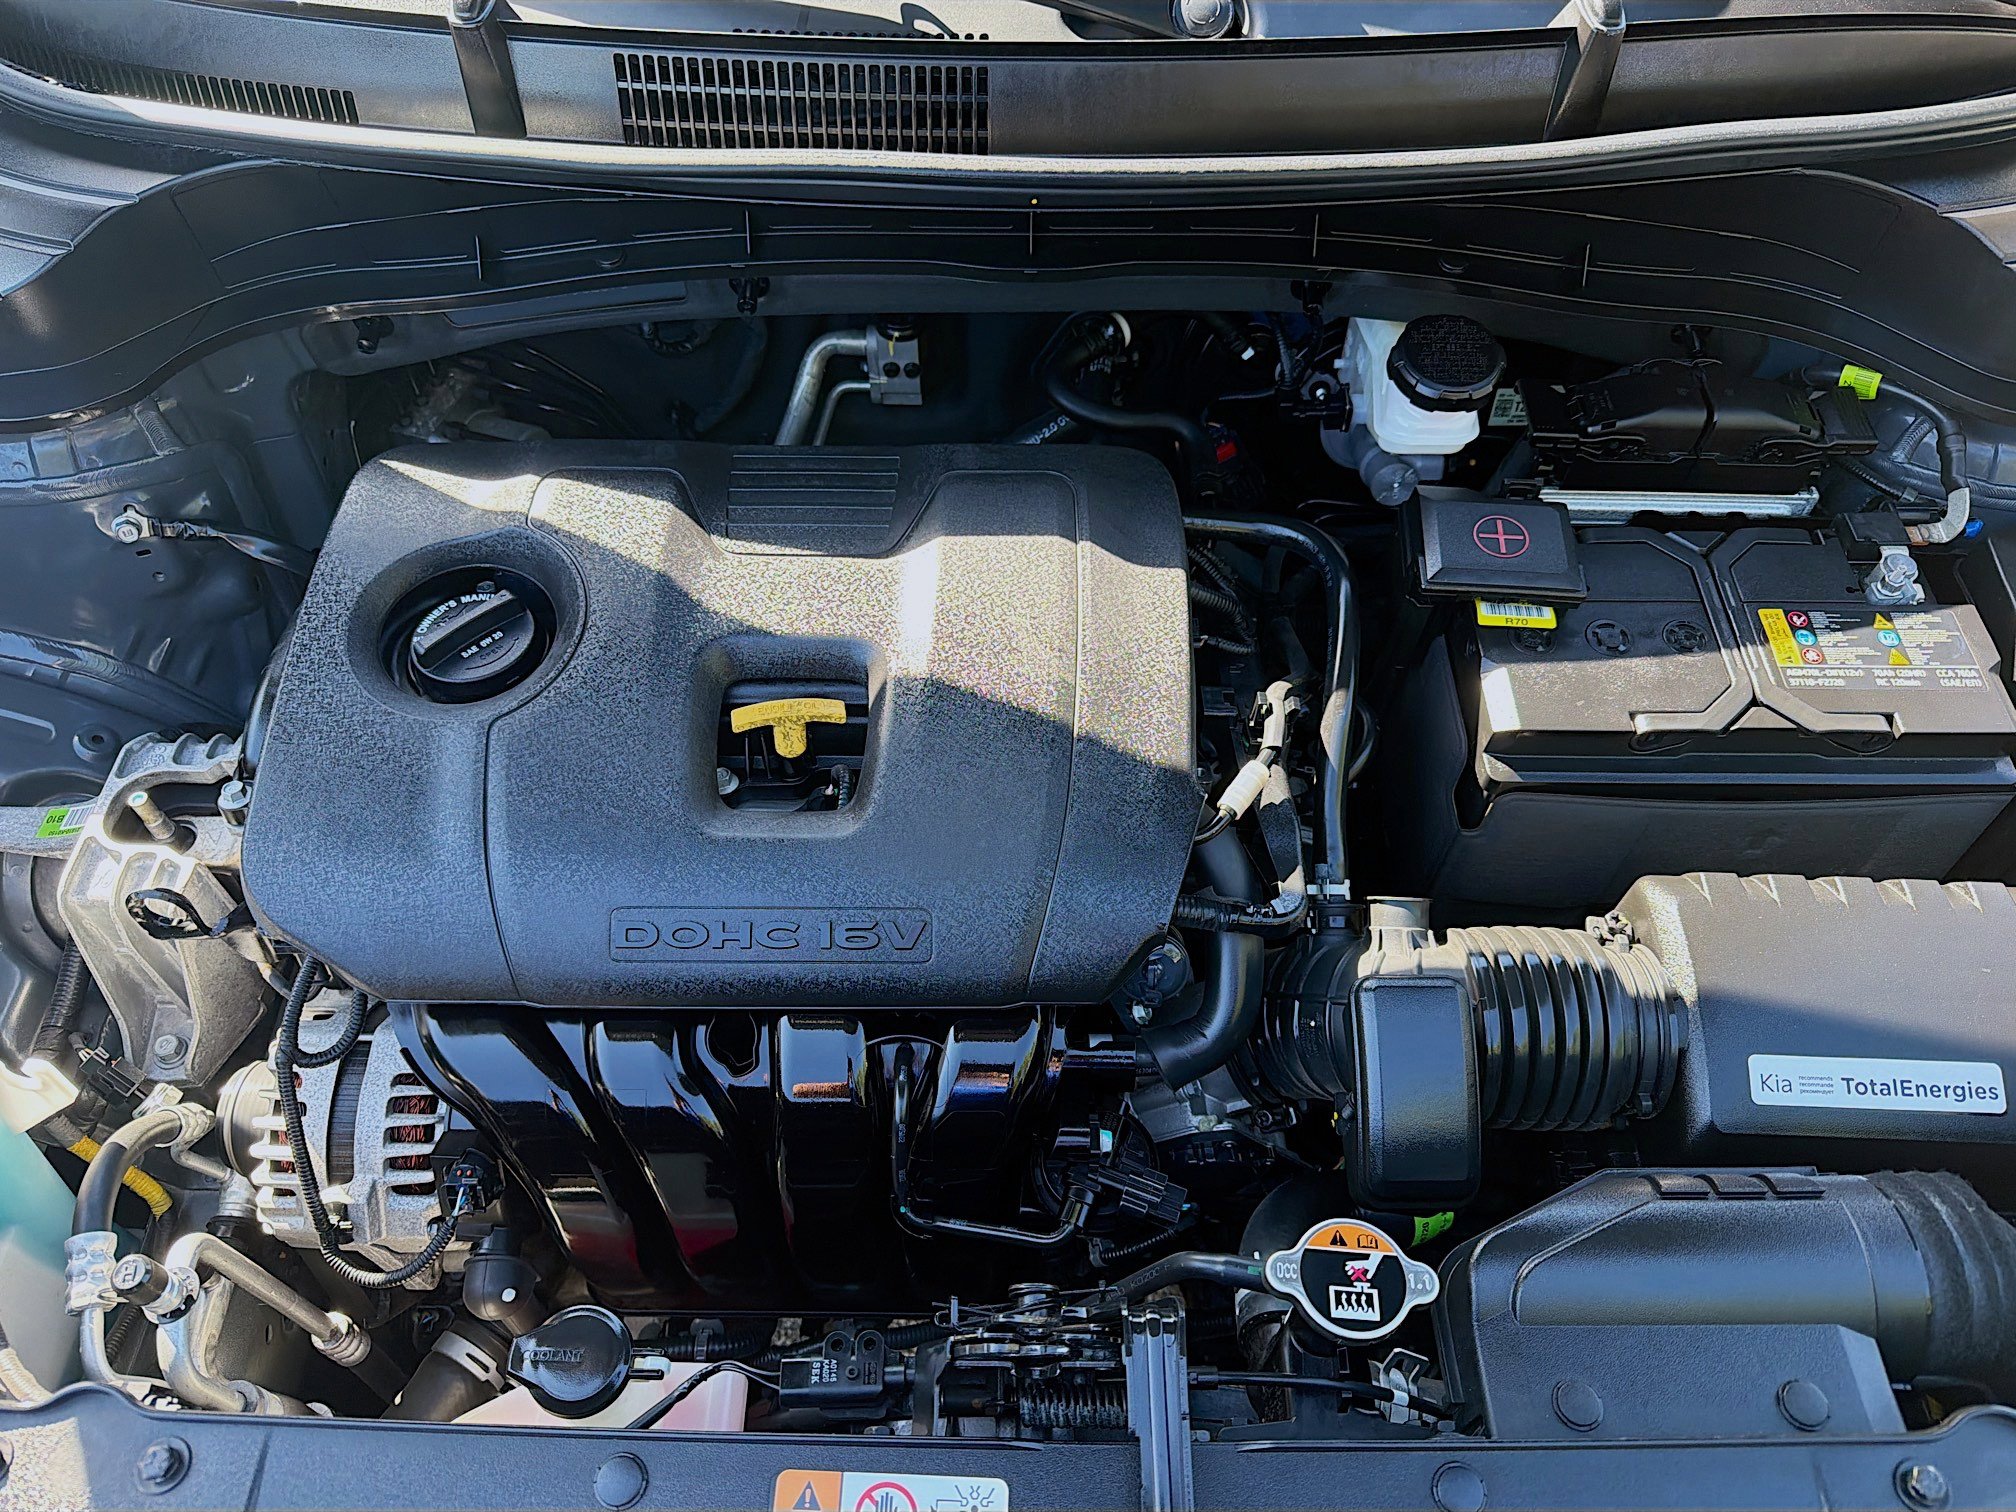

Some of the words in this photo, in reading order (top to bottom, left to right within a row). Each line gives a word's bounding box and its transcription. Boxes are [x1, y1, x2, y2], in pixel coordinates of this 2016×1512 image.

[416, 600, 458, 634] OWNER'S
[1505, 617, 1529, 626] R70
[461, 645, 480, 658] SAE
[491, 631, 504, 640] 20
[1935, 669, 1955, 678] CCA
[46, 815, 66, 824] B10
[614, 920, 801, 950] DOHC
[818, 920, 927, 951] 16V
[1760, 1073, 1793, 1093] Kia
[1840, 1077, 1999, 1103] TotalEnergies
[522, 1346, 586, 1362] COOLANT
[810, 1362, 820, 1384] SEK
[821, 1359, 830, 1383] KA020
